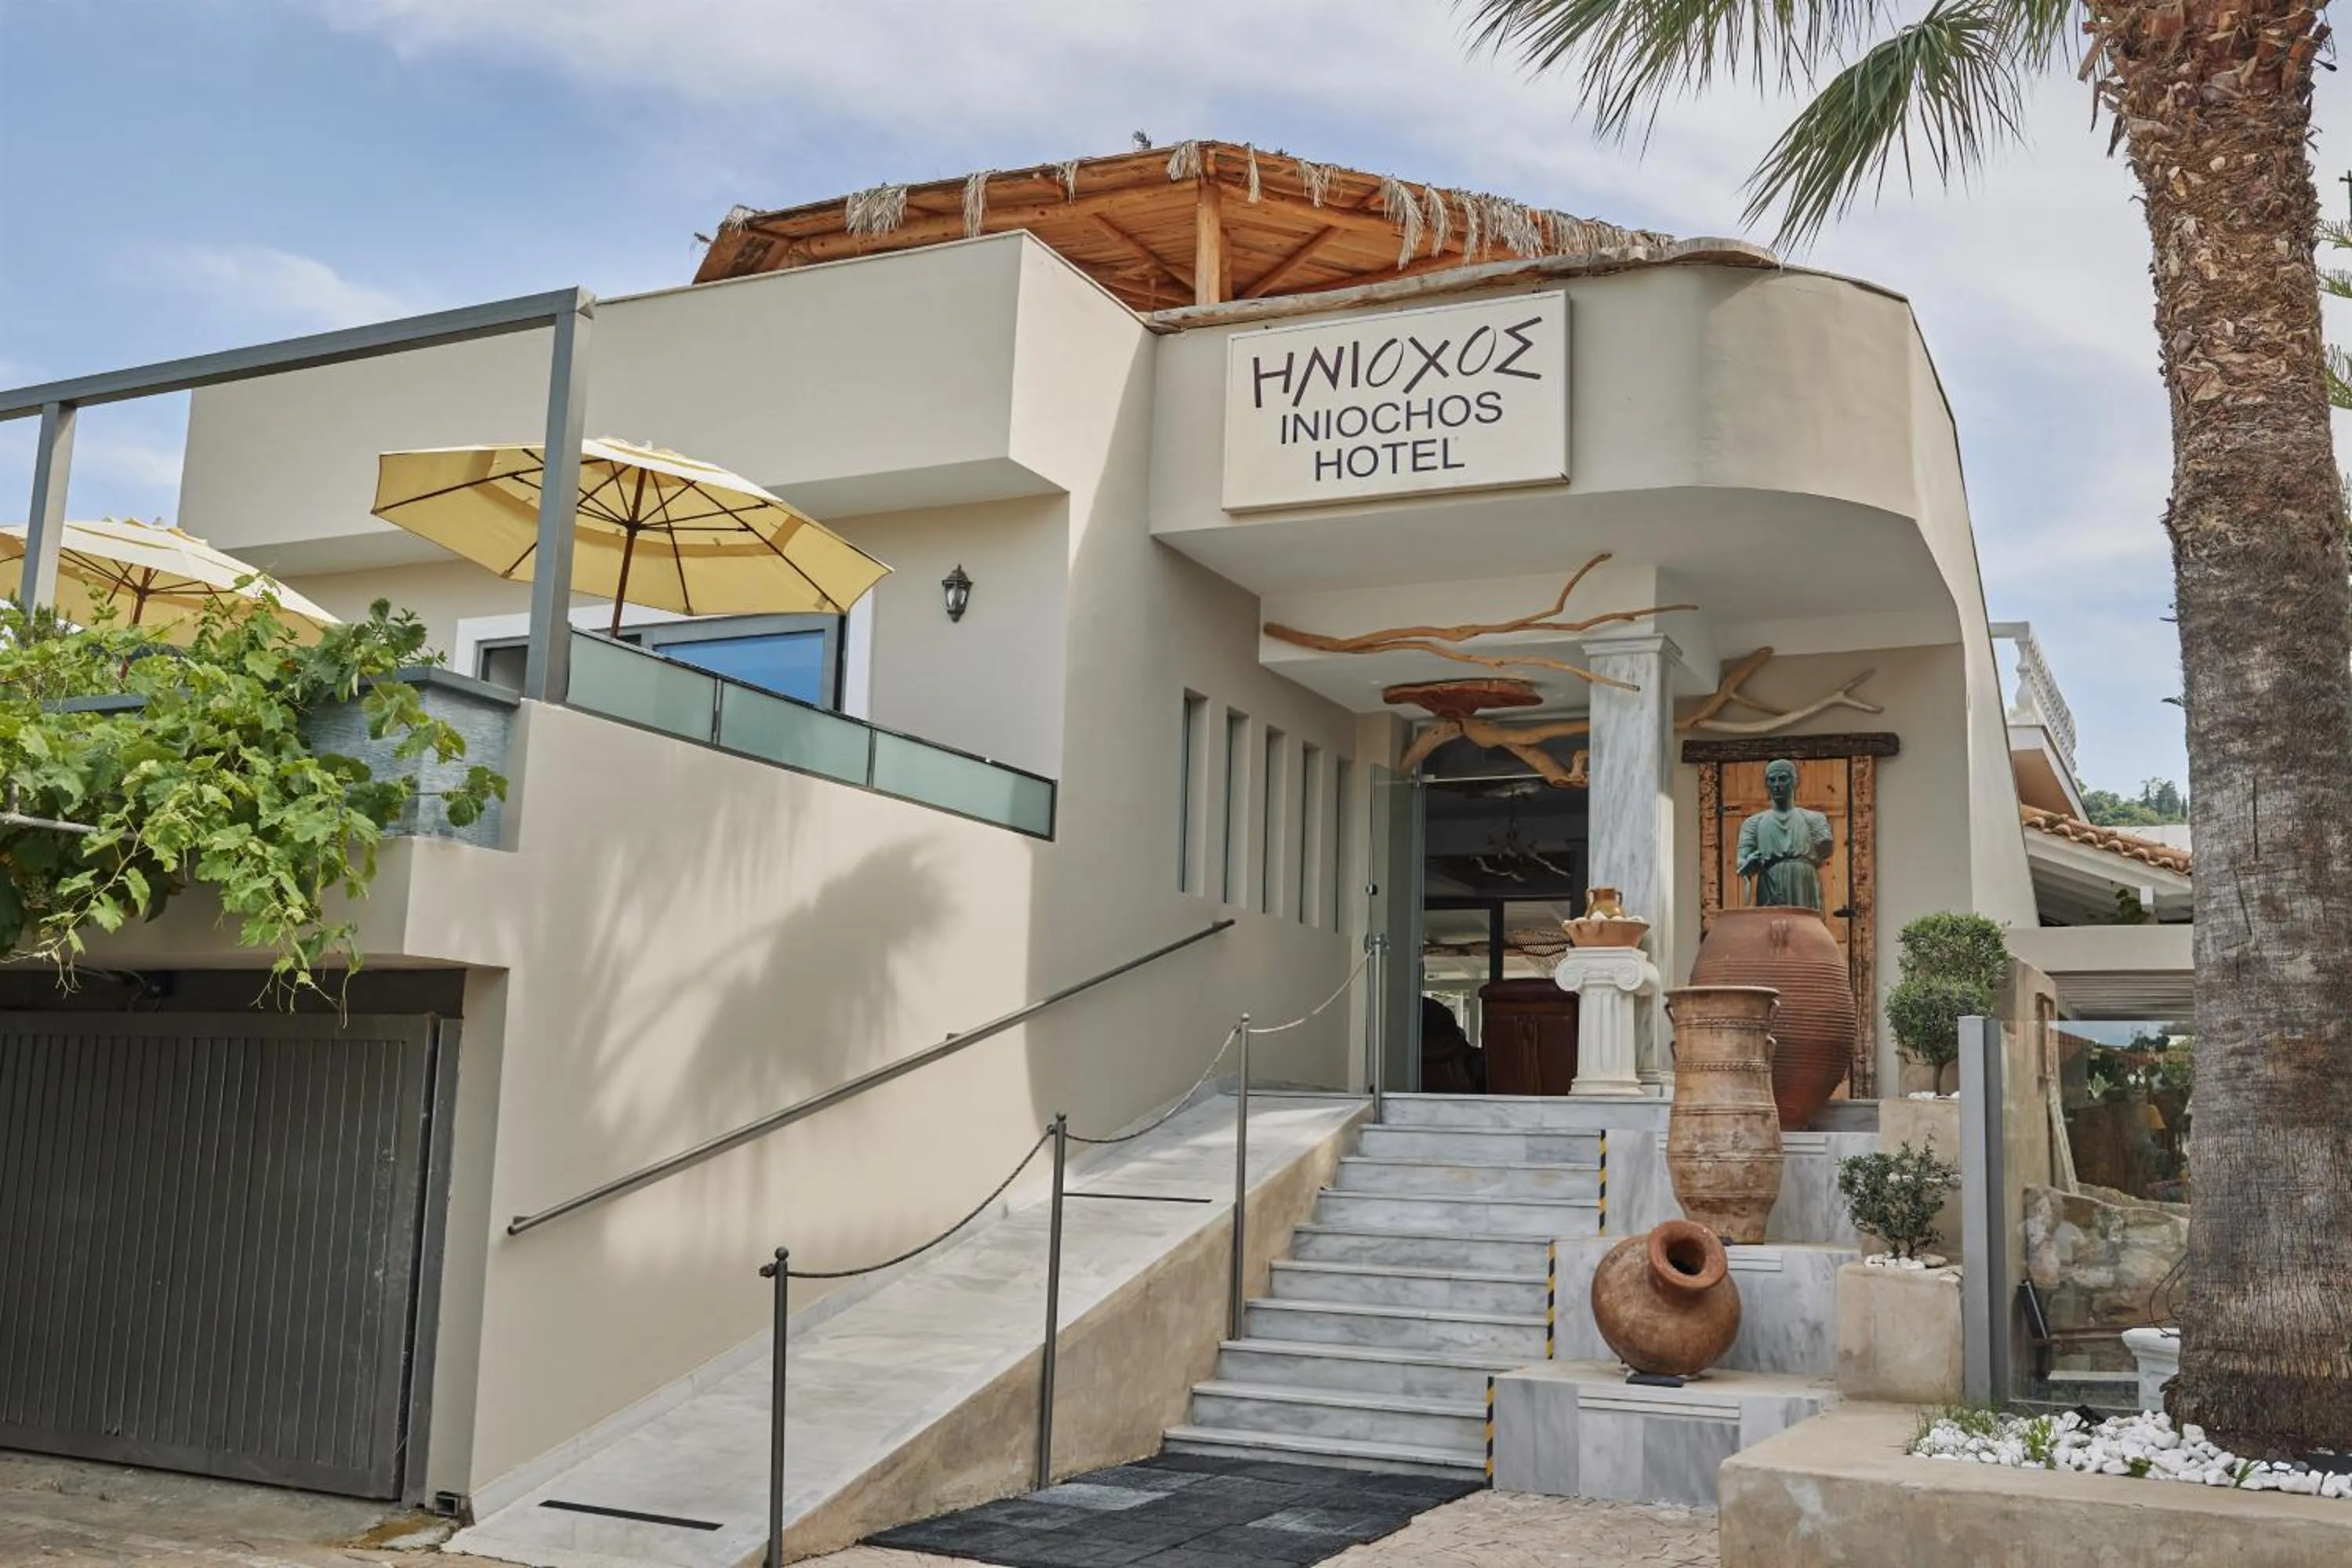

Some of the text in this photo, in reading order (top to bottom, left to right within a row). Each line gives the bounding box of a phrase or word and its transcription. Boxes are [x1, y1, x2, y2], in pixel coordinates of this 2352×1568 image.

[1253, 316, 1543, 408] ΗΝΙΟΧΟΣ
[1280, 390, 1504, 445] INIOCHOS
[1315, 437, 1466, 482] HOTEL
